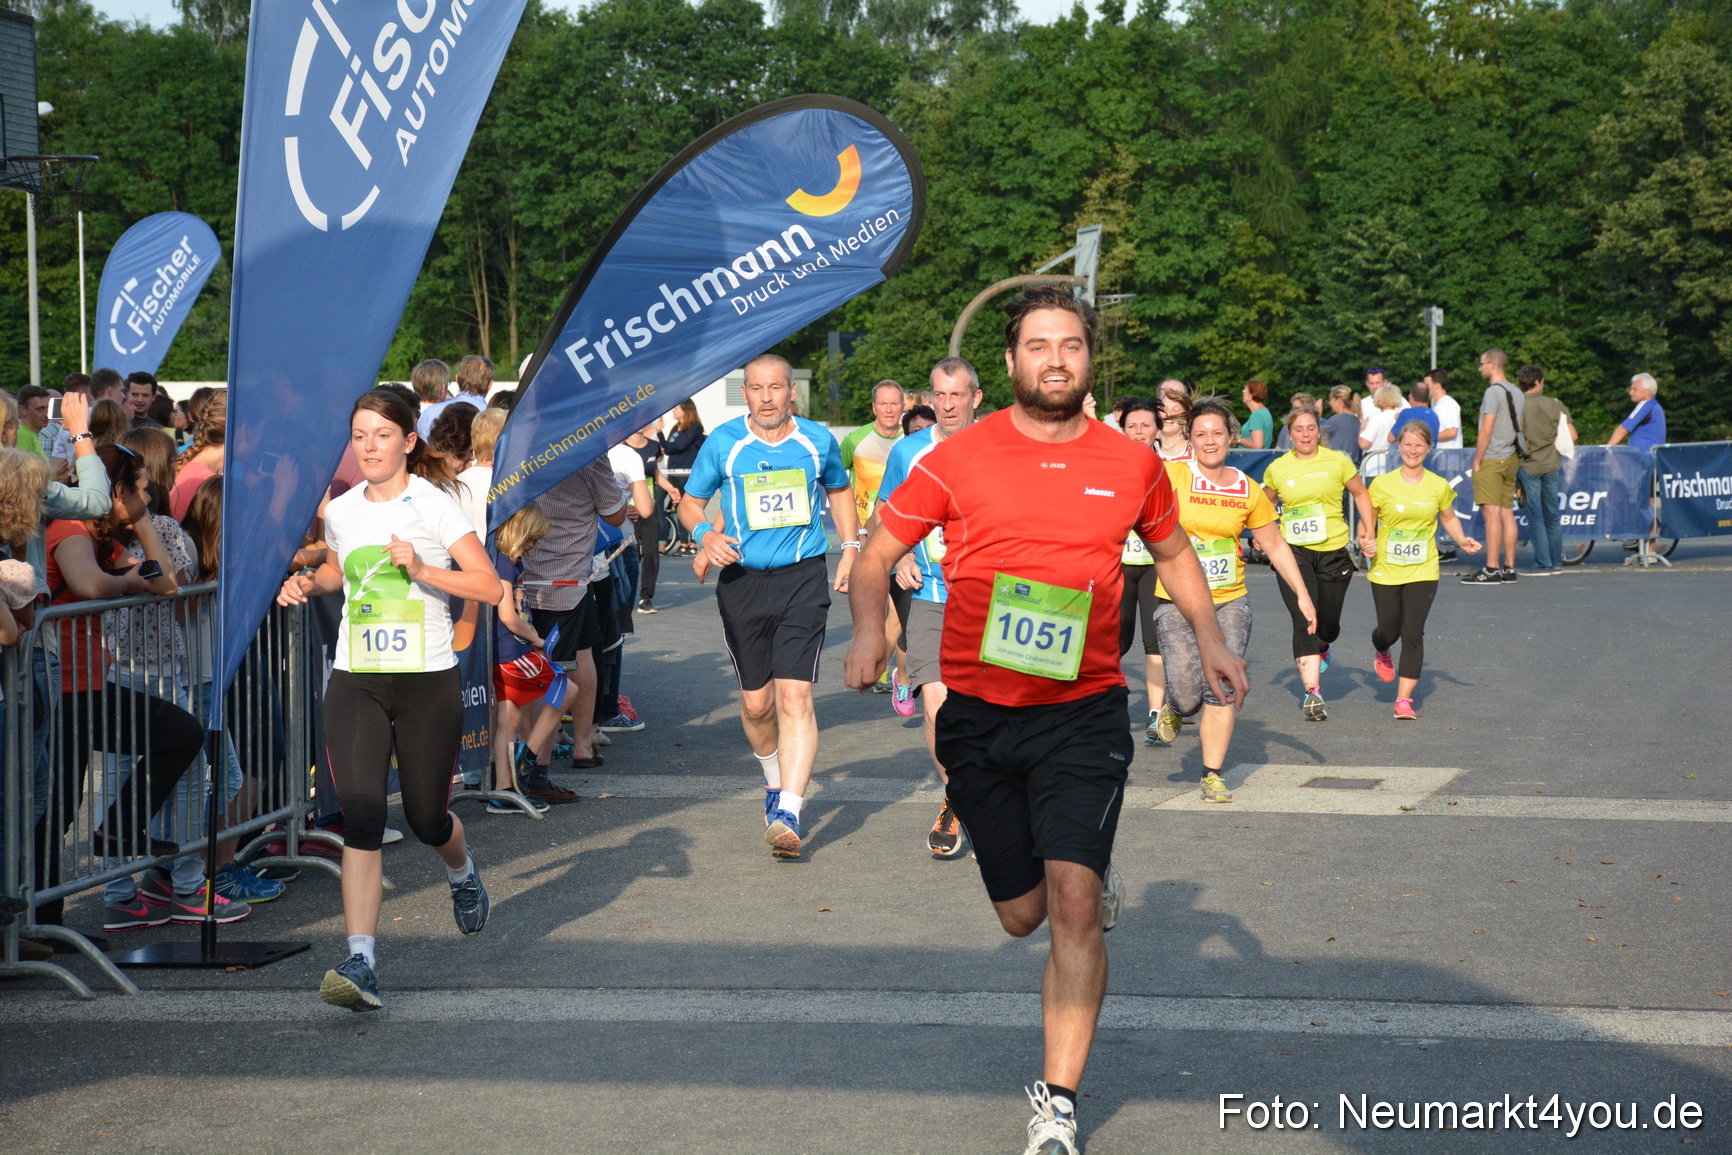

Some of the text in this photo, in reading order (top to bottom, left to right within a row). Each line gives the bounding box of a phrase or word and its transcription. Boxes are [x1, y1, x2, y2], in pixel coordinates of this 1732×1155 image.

[395, 0, 476, 168] AUTOM
[730, 209, 900, 316] Druck und Medien
[127, 235, 192, 337] Fischer
[152, 254, 201, 336] AUTOMOBILE
[564, 224, 816, 384] Frischmann
[485, 384, 657, 504] www.frischmann-net.de
[760, 492, 795, 513] 521
[1084, 487, 1116, 498] Johannes
[1662, 471, 1732, 499] Frischma
[1189, 496, 1249, 510] MAX BÖGL
[1292, 520, 1318, 535] 645
[1394, 543, 1420, 557] 646
[362, 629, 408, 652] 105
[998, 612, 1073, 654] 1051
